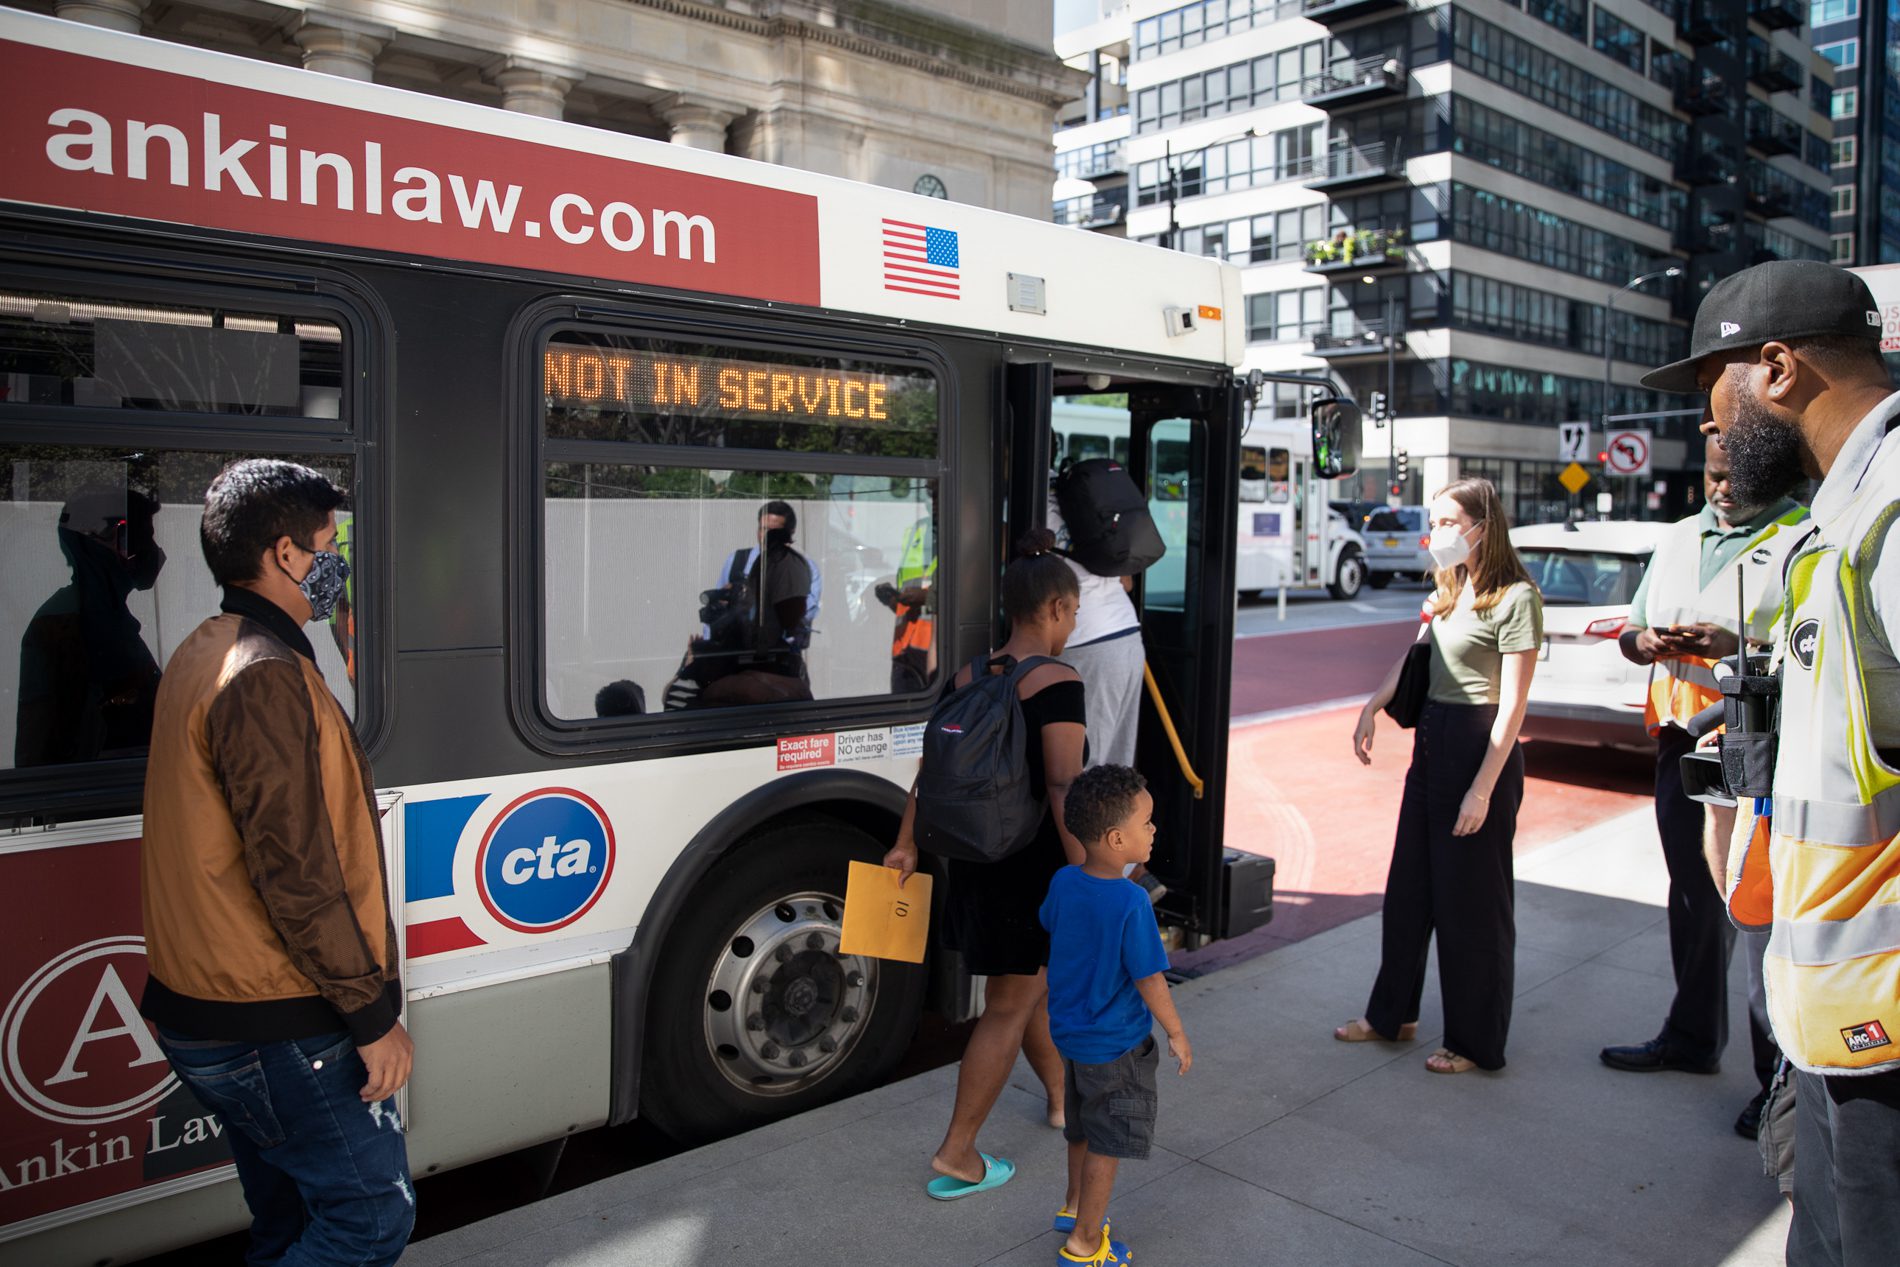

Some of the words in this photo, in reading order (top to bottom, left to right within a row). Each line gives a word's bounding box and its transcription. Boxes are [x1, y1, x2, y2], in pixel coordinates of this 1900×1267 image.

[45, 107, 717, 264] ankinlaw.com
[544, 352, 630, 401] NOT
[653, 361, 699, 406] IN
[718, 368, 887, 421] SERVICE
[780, 739, 808, 751] Exact
[810, 738, 829, 748] fare
[838, 734, 865, 745] Driver
[867, 732, 884, 742] has
[838, 745, 853, 755] NO
[855, 743, 888, 753] change
[780, 748, 822, 763] required
[501, 836, 592, 885] cta
[44, 963, 169, 1087] A
[1848, 1033, 1870, 1047] ARC
[1868, 1024, 1880, 1039] 1
